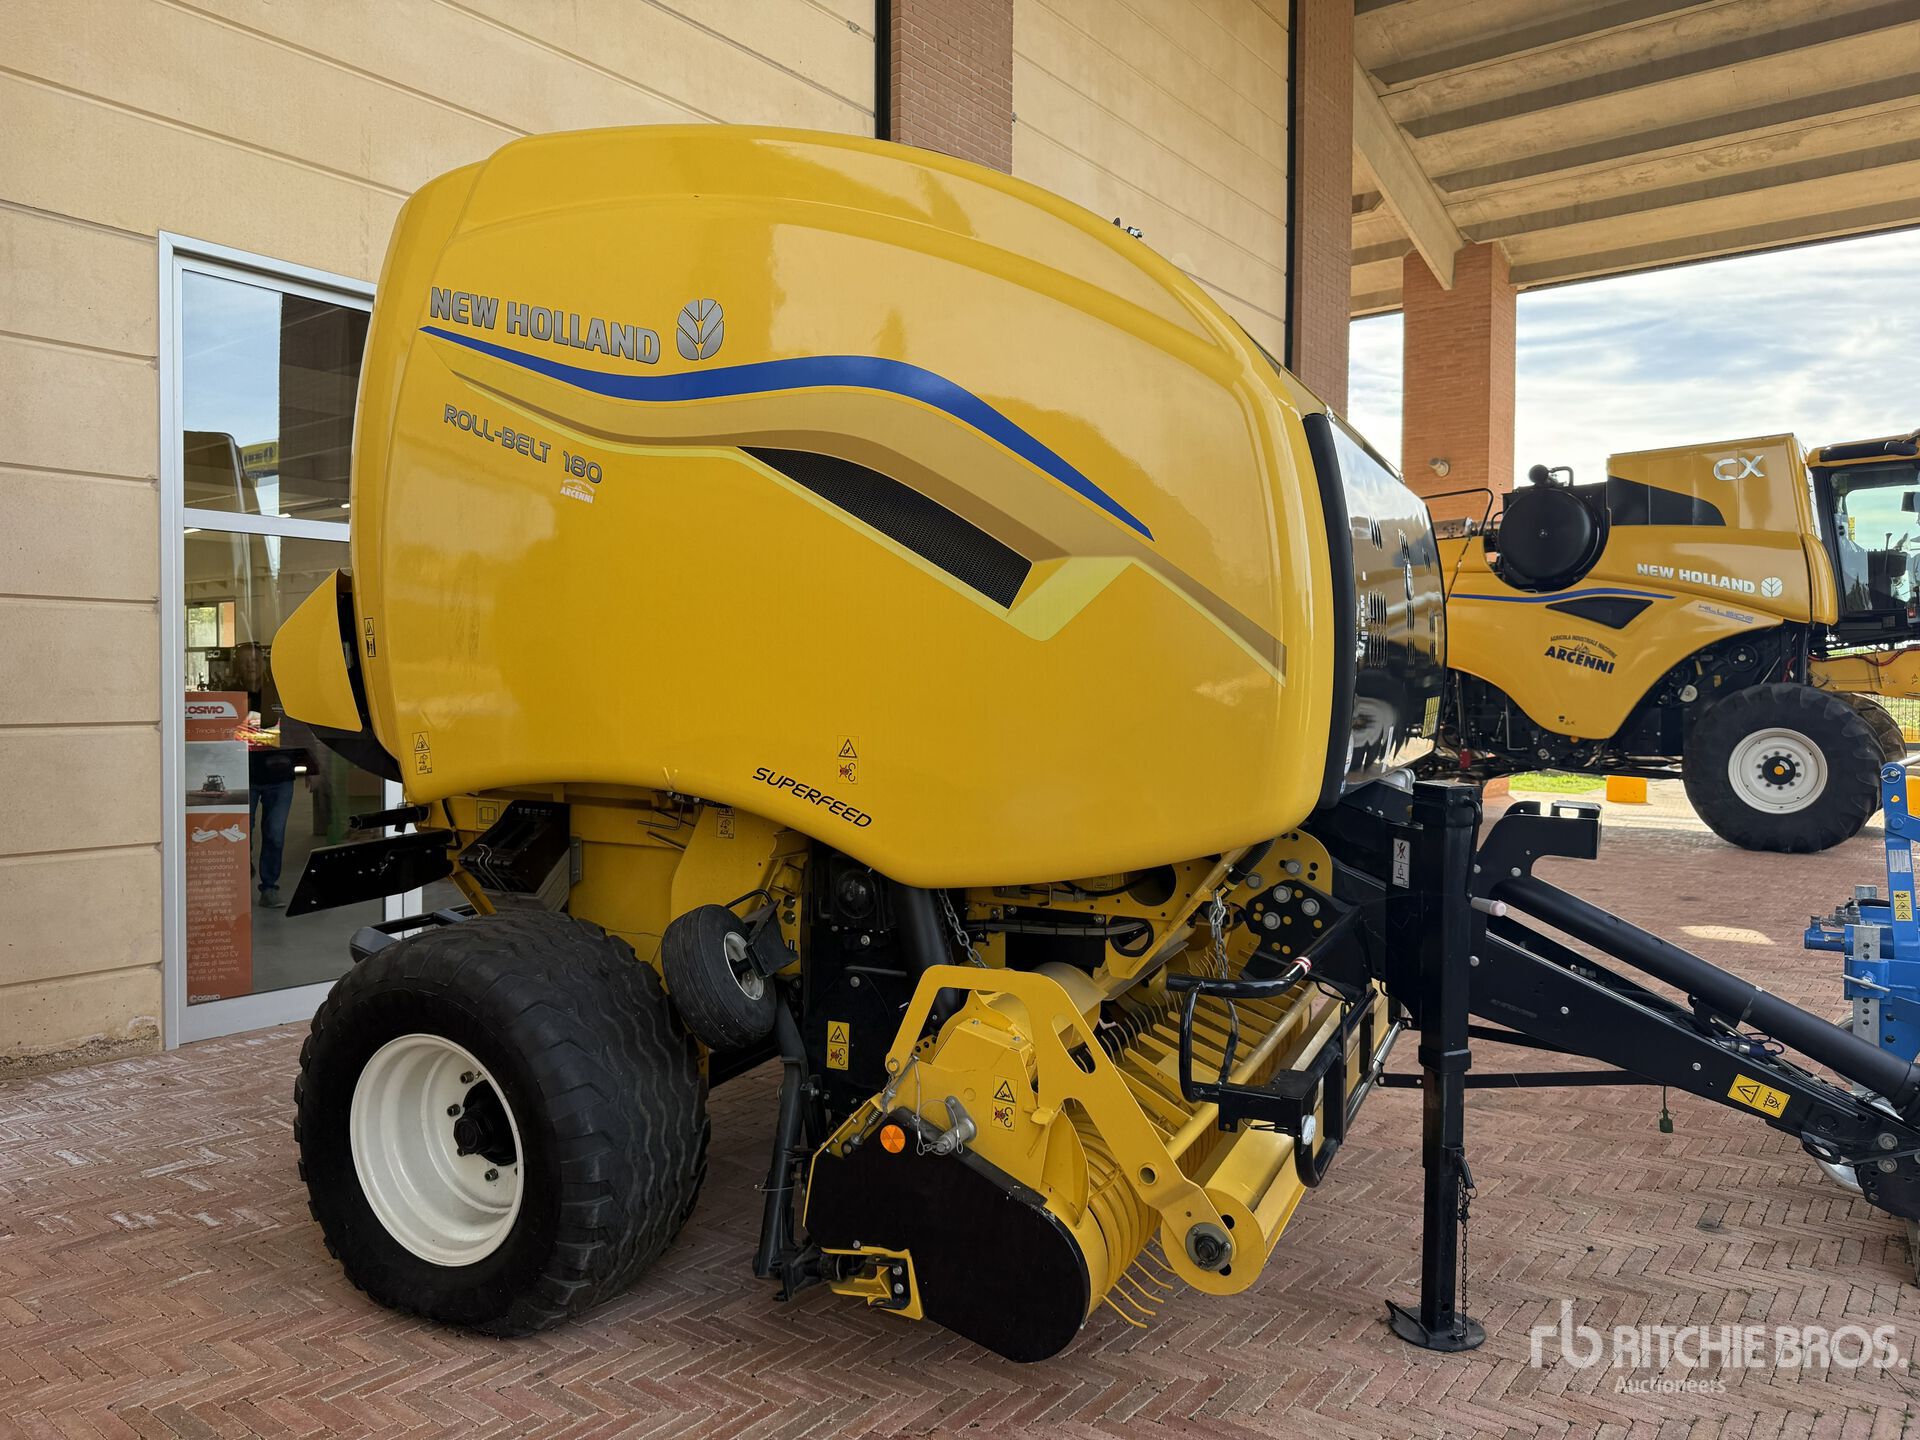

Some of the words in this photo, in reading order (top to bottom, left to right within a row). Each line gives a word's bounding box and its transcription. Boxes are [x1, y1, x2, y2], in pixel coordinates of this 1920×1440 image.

[430, 287, 499, 329] NEW
[506, 301, 660, 364] HOLLAND
[443, 403, 551, 463] ROLL-BELT
[562, 451, 603, 483] 180
[1712, 455, 1765, 481] CX
[560, 486, 594, 504] ARCENNI
[1637, 563, 1674, 578] NEW
[1679, 569, 1756, 594] HOLLAND
[1544, 645, 1615, 674] ARCENNI
[185, 705, 225, 715] OSMO
[752, 767, 872, 828] SUPERFEED
